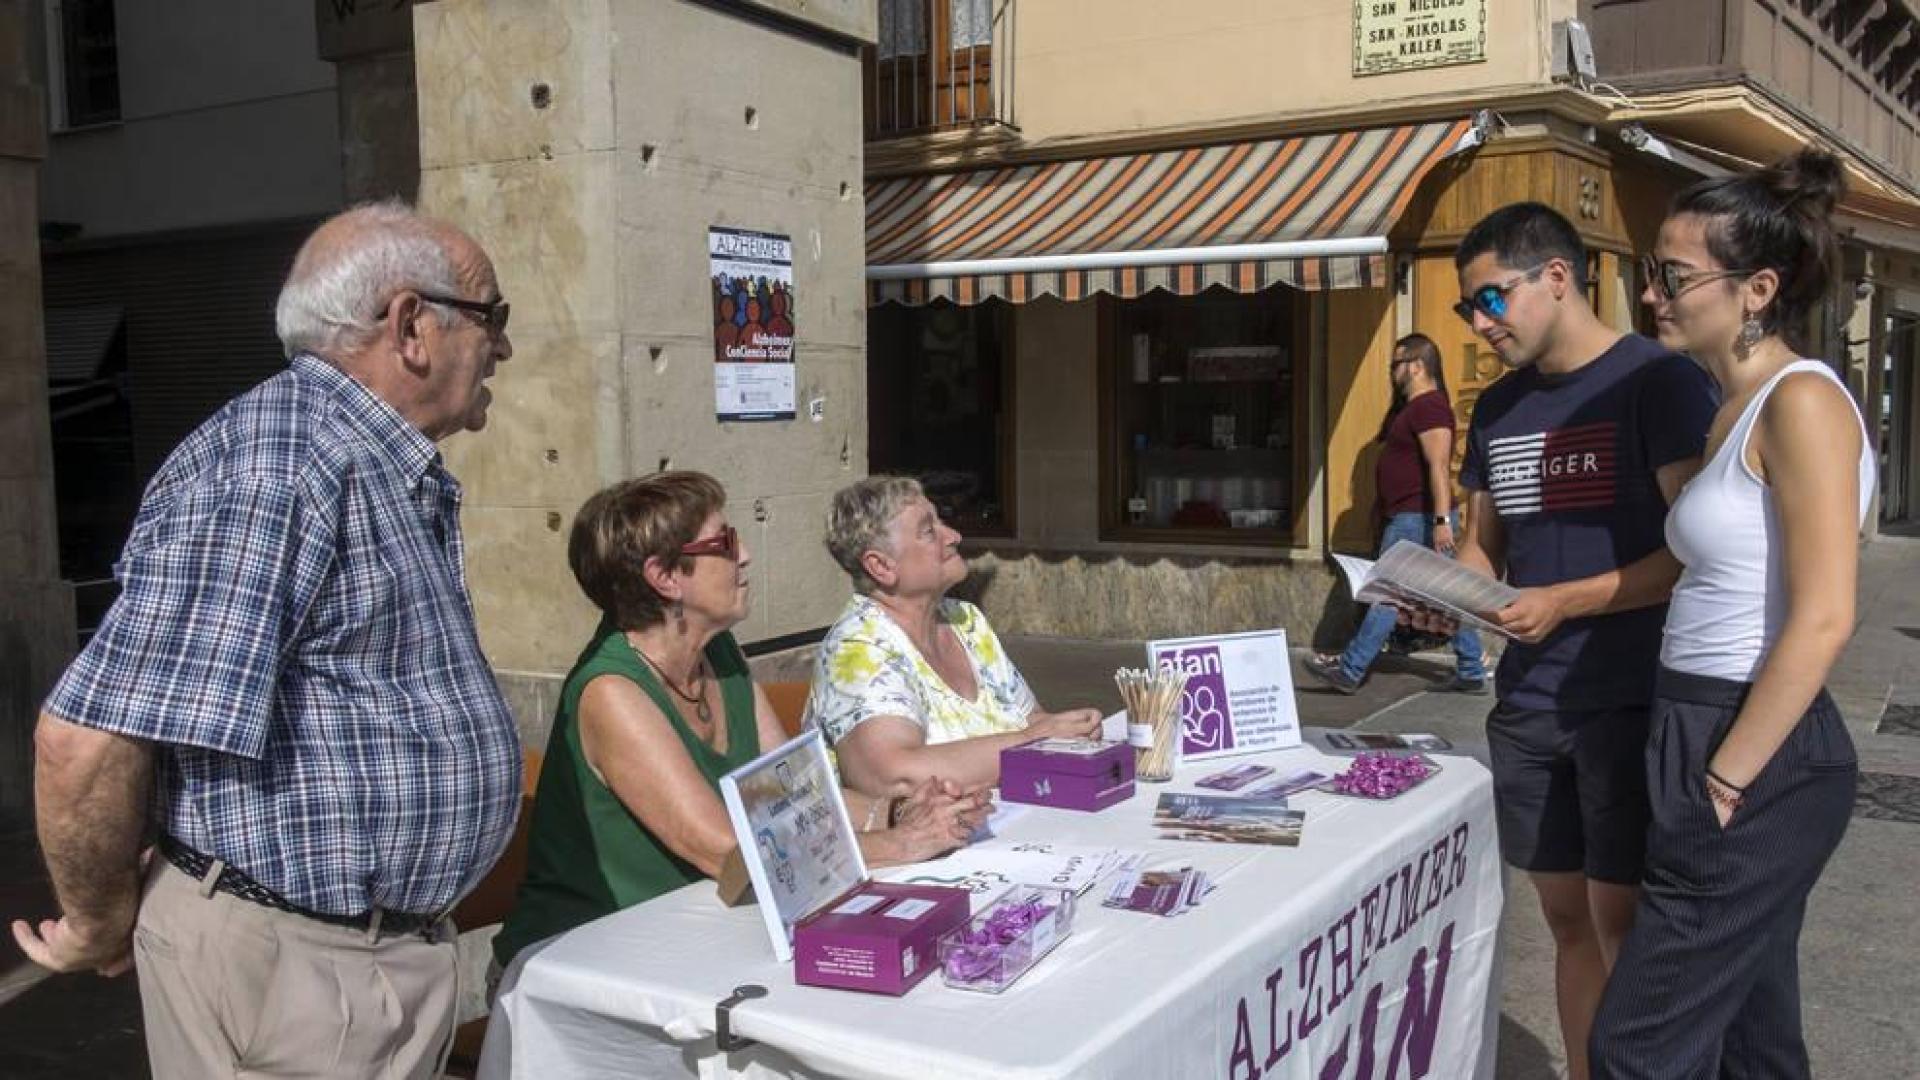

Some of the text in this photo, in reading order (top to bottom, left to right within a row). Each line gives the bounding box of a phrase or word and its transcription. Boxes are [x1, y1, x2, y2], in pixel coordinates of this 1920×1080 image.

[1372, 2, 1396, 17] SAN
[1369, 19, 1466, 43] SAN NIKOLAS
[1400, 38, 1441, 55] KALEA
[716, 235, 786, 258] ALZHEIMER
[1159, 650, 1220, 678] afan
[1230, 822, 1468, 1080] ALZHEIMER
